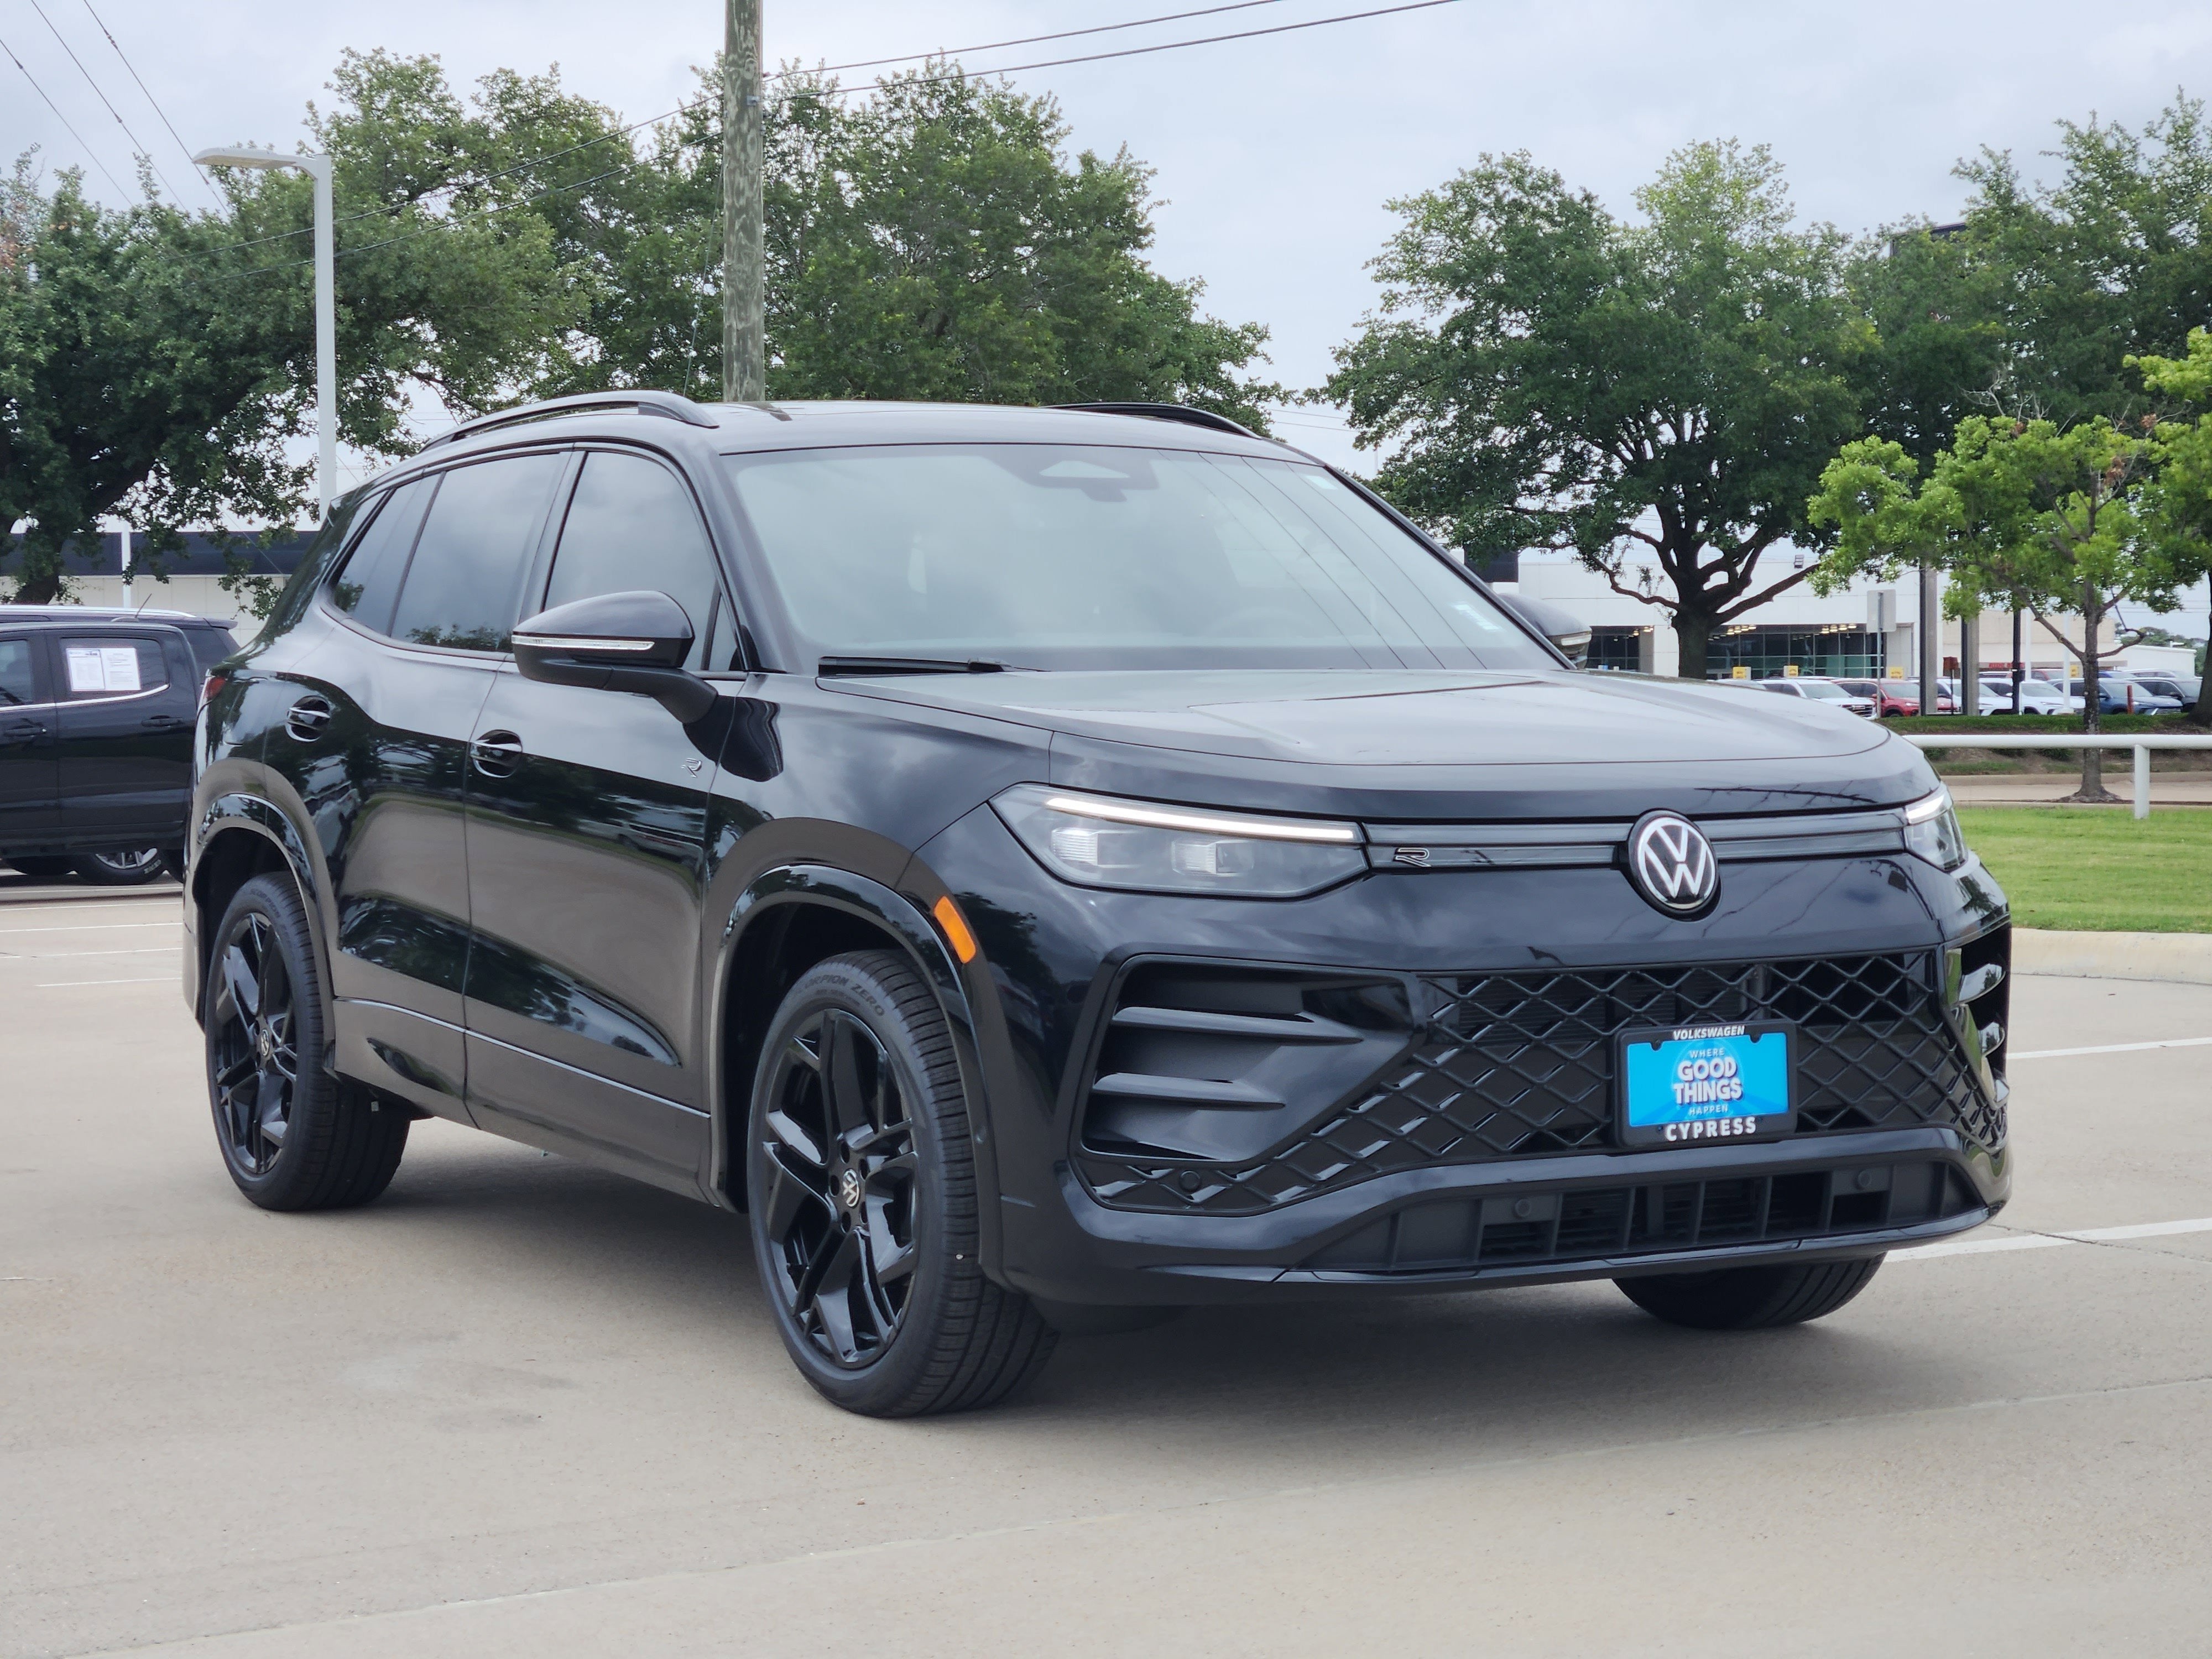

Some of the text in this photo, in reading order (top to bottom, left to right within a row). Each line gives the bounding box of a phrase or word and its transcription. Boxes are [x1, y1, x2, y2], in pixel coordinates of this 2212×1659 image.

[1395, 848, 1431, 868] R
[1639, 820, 1713, 904] VW
[851, 984, 884, 1016] ZERO
[1673, 1025, 1745, 1041] VOLKSWAGEN
[1689, 1047, 1725, 1058] WHERE
[1677, 1057, 1738, 1081] GOOD
[1673, 1078, 1743, 1104] THINGS
[1689, 1105, 1729, 1117] HAPPEN
[1665, 1117, 1756, 1141] CYPRESS
